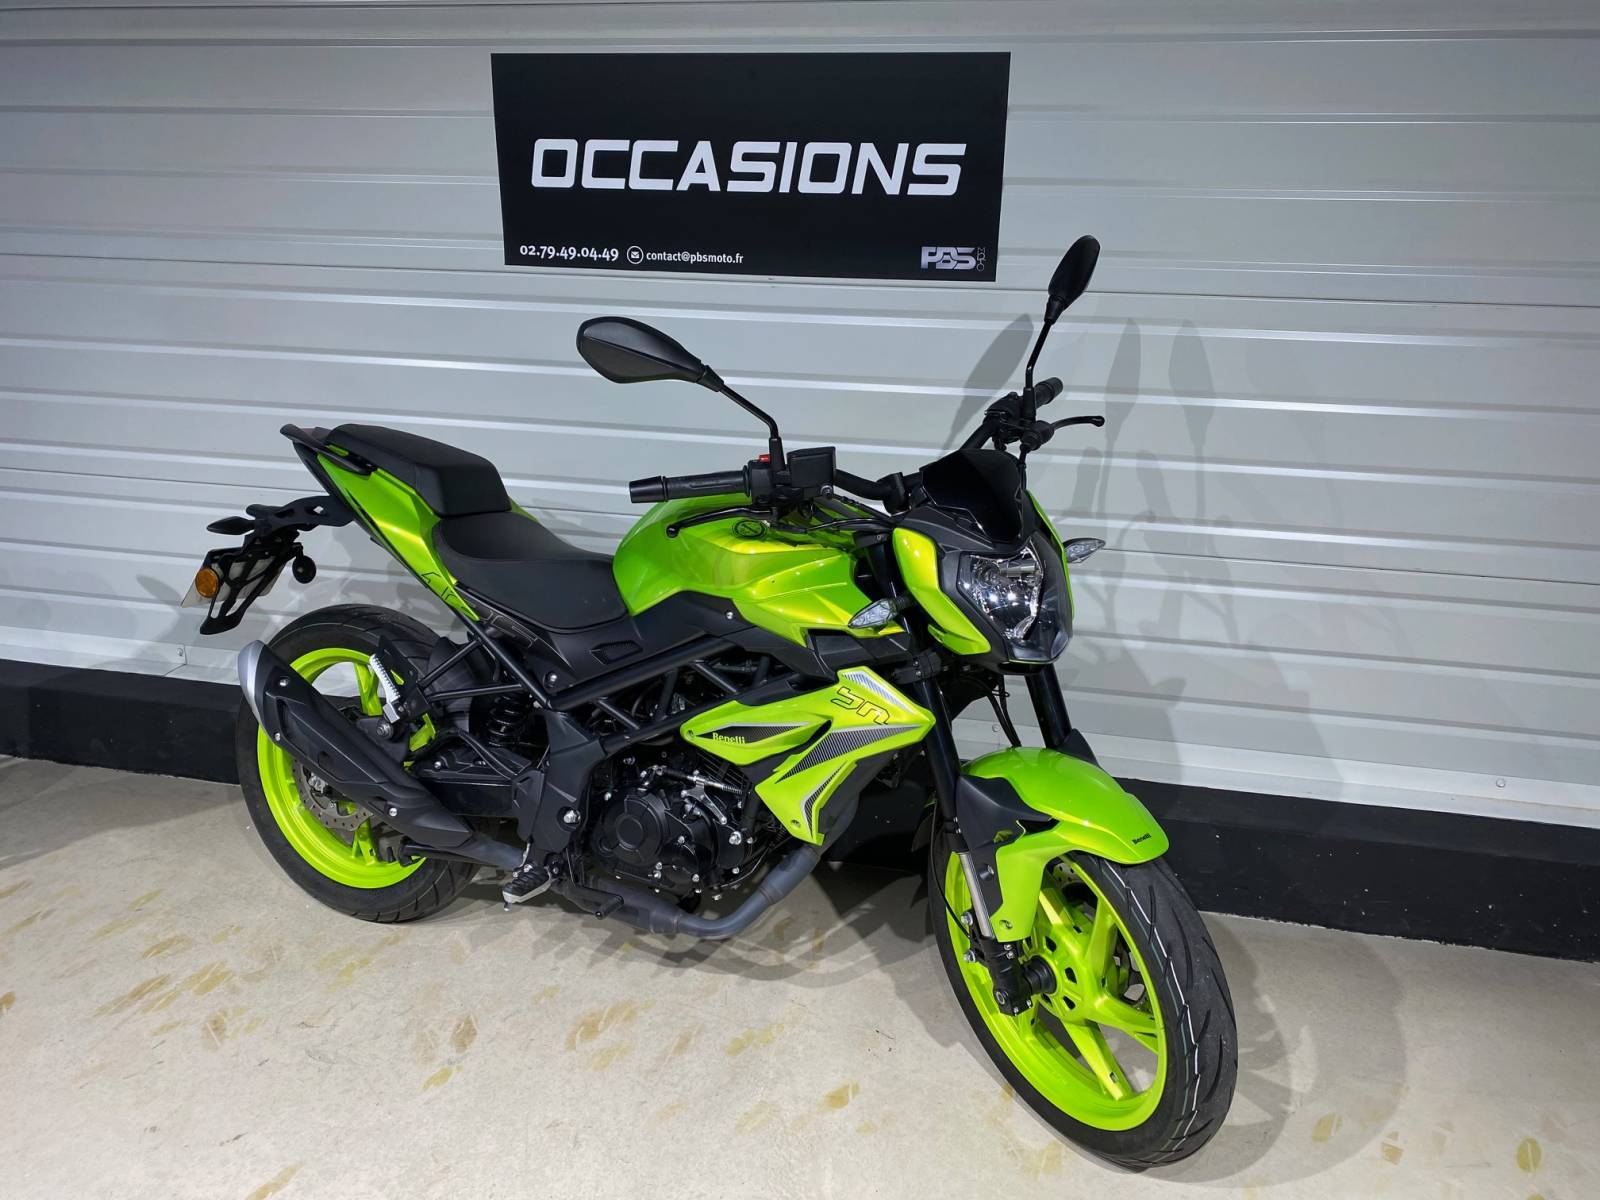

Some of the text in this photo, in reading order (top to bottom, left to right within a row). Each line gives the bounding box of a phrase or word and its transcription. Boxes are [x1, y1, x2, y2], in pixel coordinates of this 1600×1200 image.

[531, 138, 967, 196] OCCASIONS
[519, 245, 744, 264] 02.79.49.04.49 contact@pbsmoto.fr
[920, 246, 977, 271] PBS
[712, 731, 746, 745] Benelli
